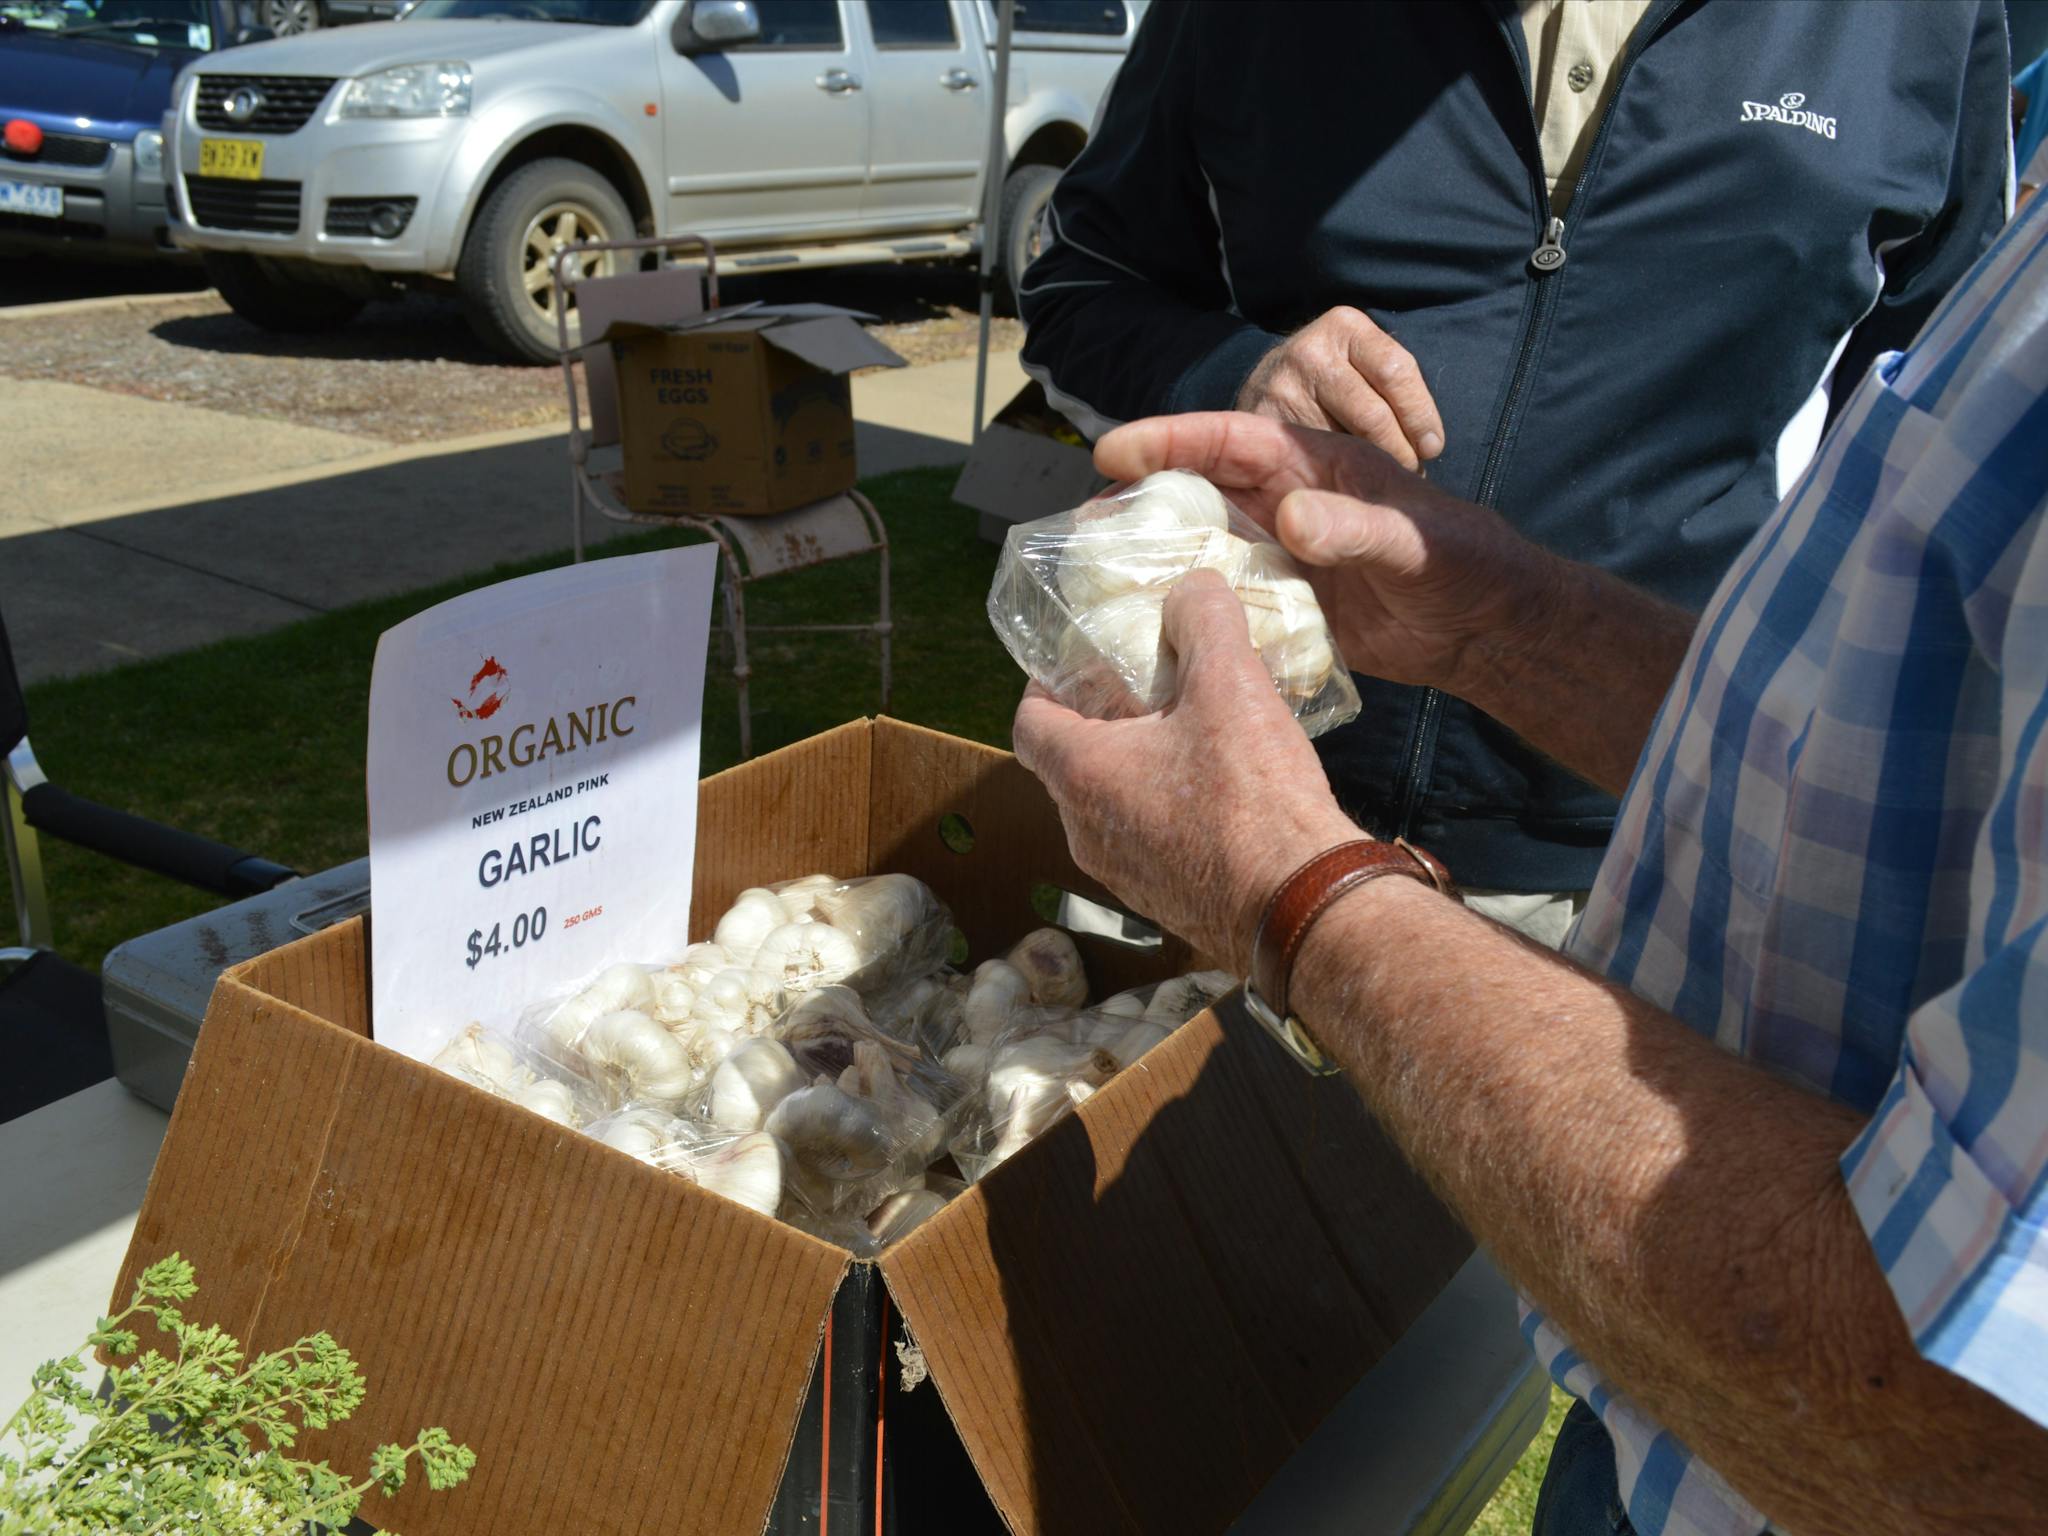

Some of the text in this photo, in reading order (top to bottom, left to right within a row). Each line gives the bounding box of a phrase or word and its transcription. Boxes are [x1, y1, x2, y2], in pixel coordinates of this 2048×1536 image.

[1741, 101, 1837, 140] SPALDING
[650, 367, 713, 385] FRESH
[658, 387, 710, 405] EGGS
[447, 696, 635, 788] ORGANIC
[472, 773, 609, 829] NEW ZEALAND PINK
[479, 815, 601, 888] GARLIC
[466, 905, 603, 970] $4.00 250 GMS
